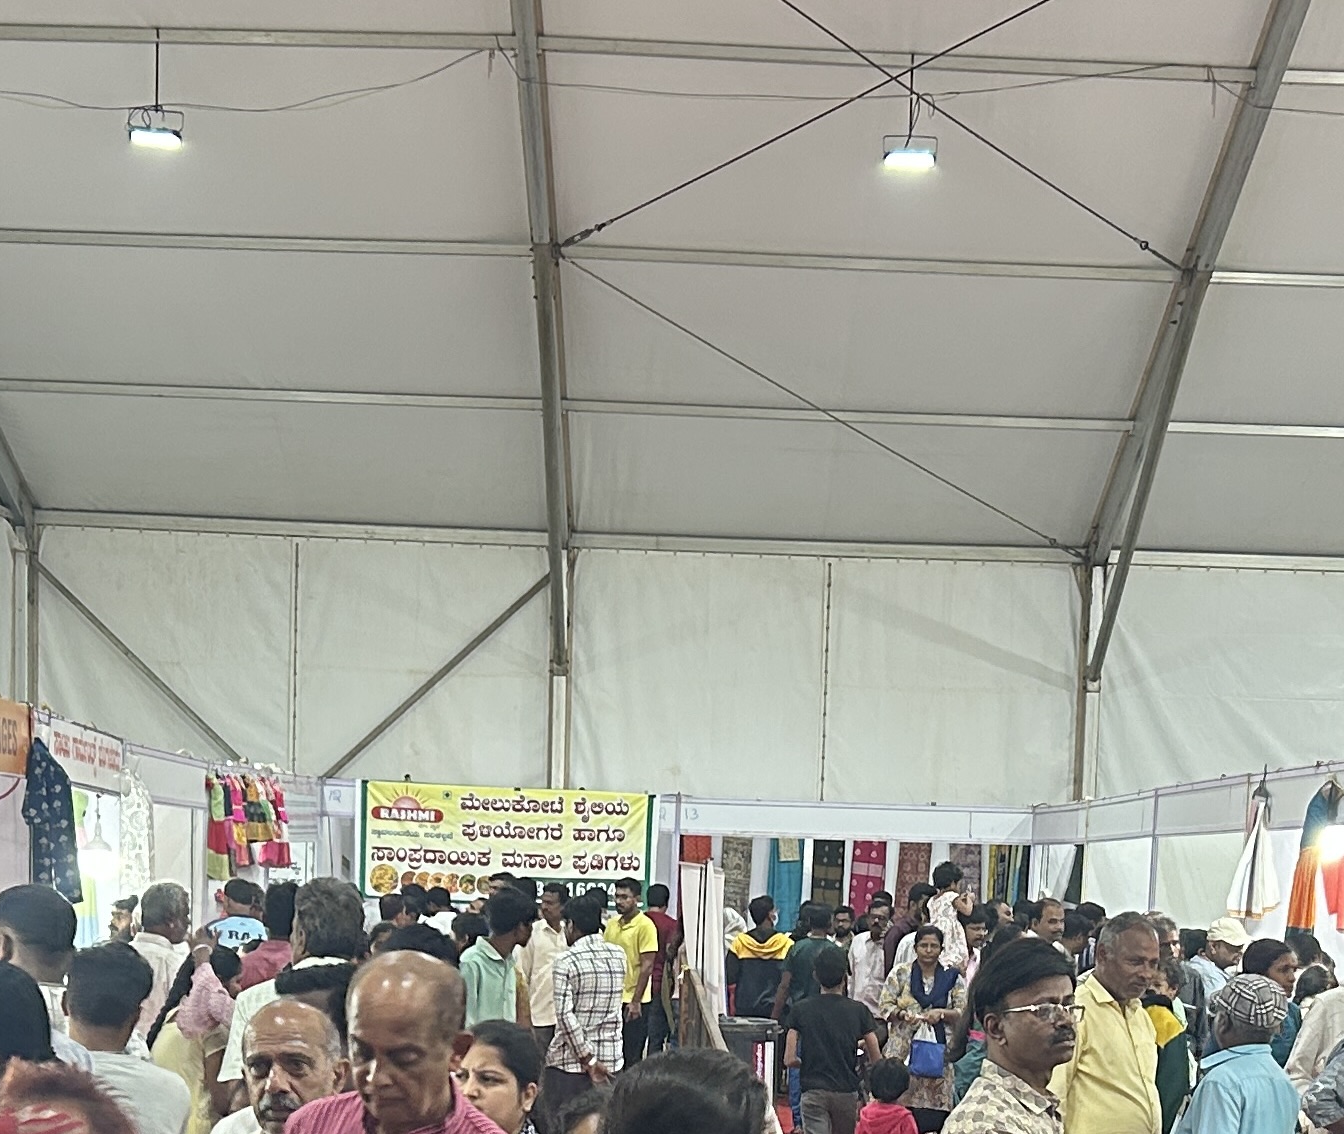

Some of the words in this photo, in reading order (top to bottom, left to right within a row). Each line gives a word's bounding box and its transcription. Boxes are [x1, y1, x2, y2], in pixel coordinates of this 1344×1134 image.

[460, 793, 564, 816] ಮೇಲುಕೋಟೆ
[574, 794, 630, 823] ಶೈಲಿಯ
[572, 825, 626, 843] ಹಾಗೂ
[371, 844, 492, 870] ಸಾಂಪ್ರದಾಯಿಕ
[501, 848, 563, 870] ಮಸಾಲ
[572, 851, 641, 875] ಪುಡಿಗಳು
